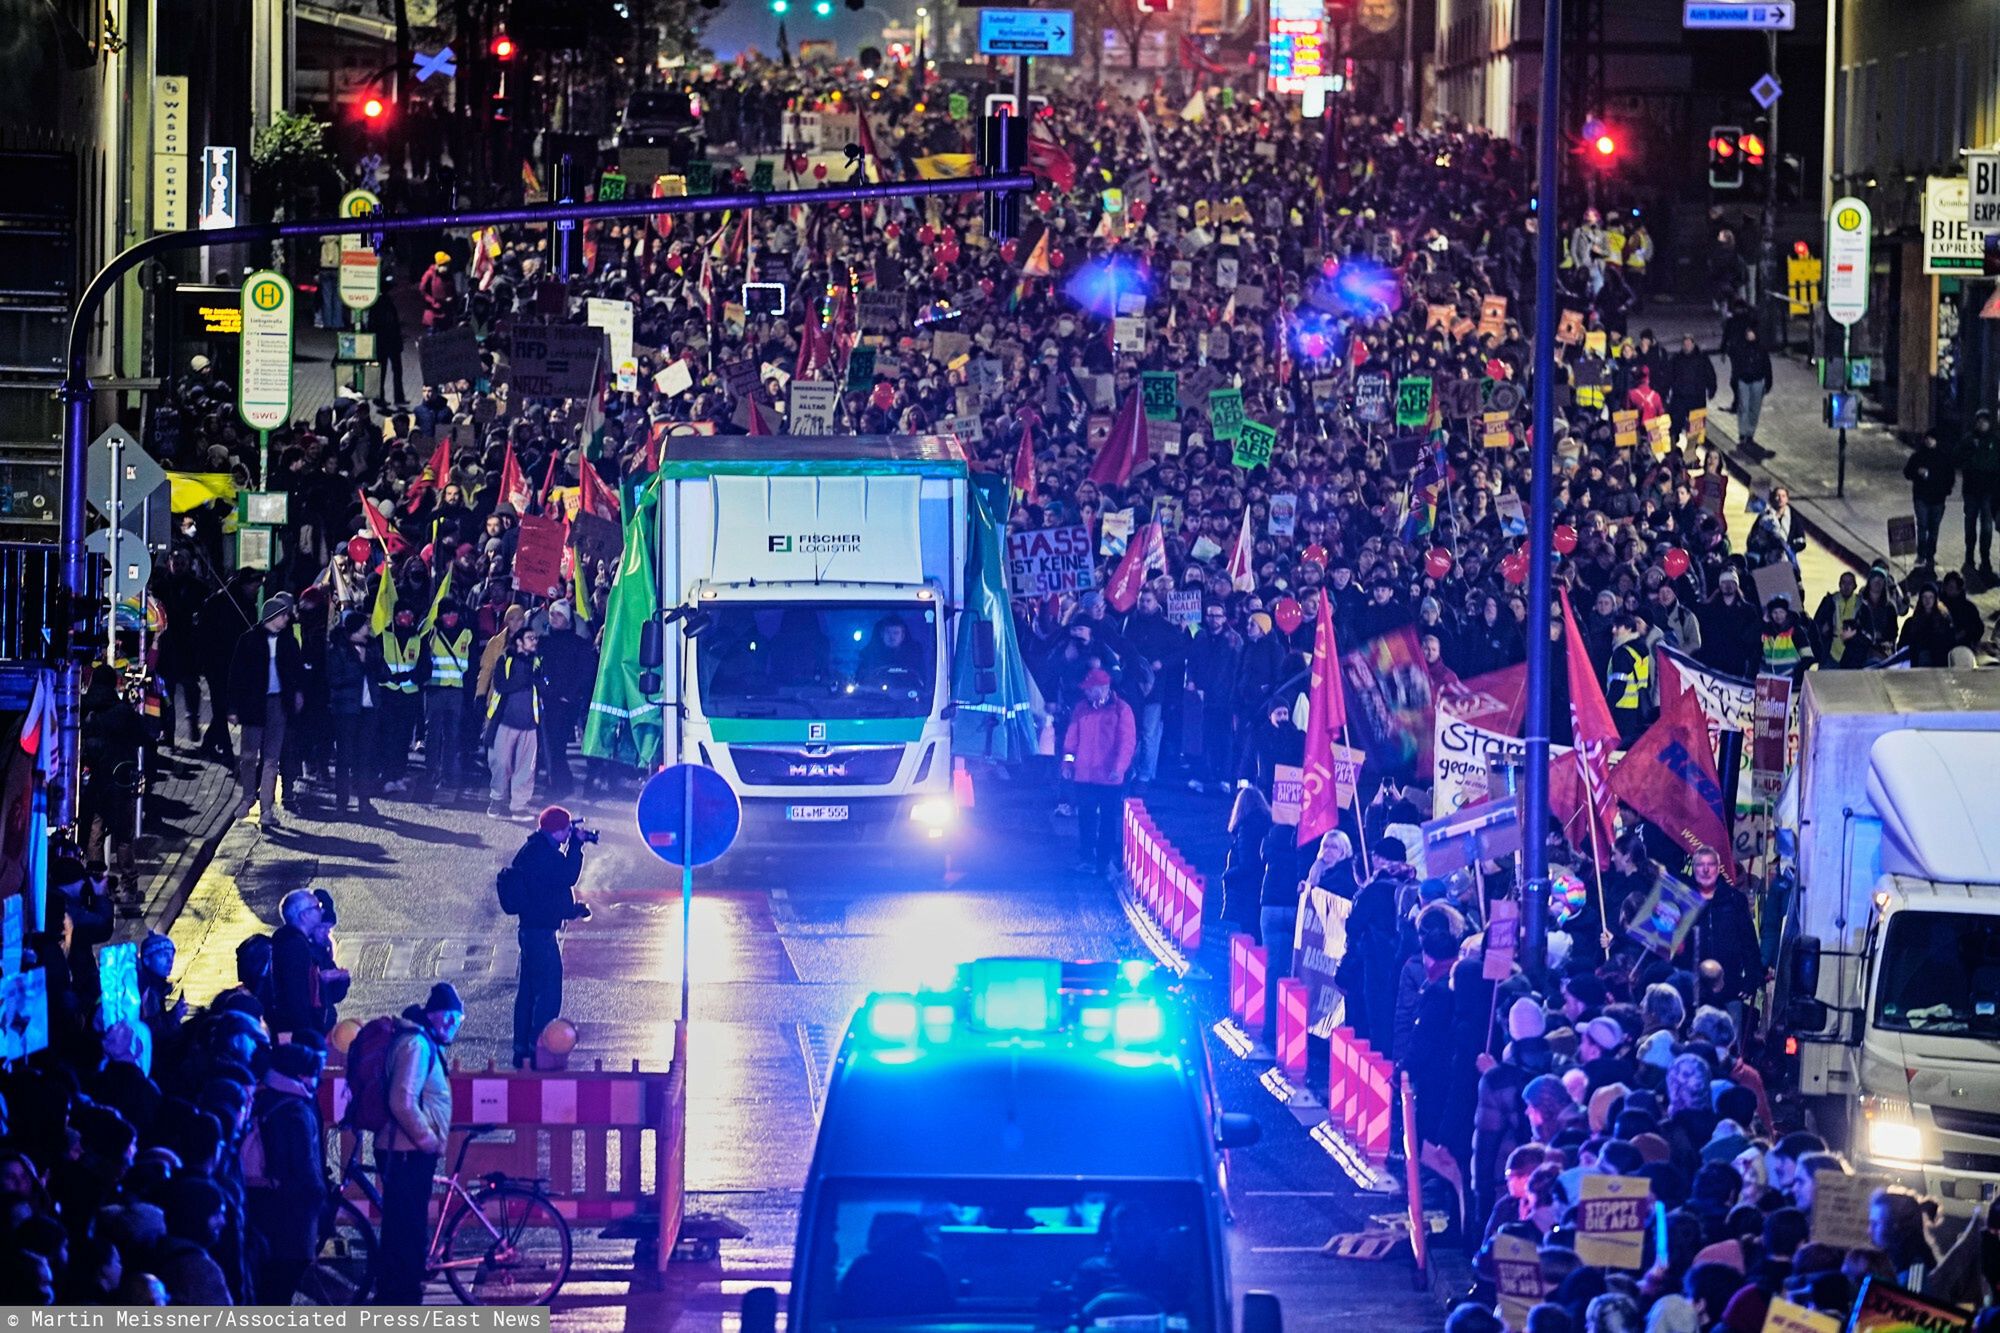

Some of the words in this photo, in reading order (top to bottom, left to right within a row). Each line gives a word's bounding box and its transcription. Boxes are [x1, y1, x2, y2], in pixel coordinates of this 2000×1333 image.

[1400, 385, 1430, 399] FCK
[252, 412, 278, 420] SWG
[1241, 428, 1270, 447] FCK
[1237, 440, 1270, 460] AFD
[799, 535, 861, 543] FISCHER
[1007, 527, 1091, 560] HASS
[799, 544, 861, 553] LOGISTIK
[1010, 559, 1034, 575] IST
[1039, 555, 1090, 573] KEINE
[789, 763, 845, 776] MAN
[792, 807, 804, 817] GI
[828, 807, 847, 817] 555
[1585, 1201, 1638, 1216] STOPPT
[1585, 1216, 1608, 1230] DIE
[1610, 1215, 1640, 1228] AFD
